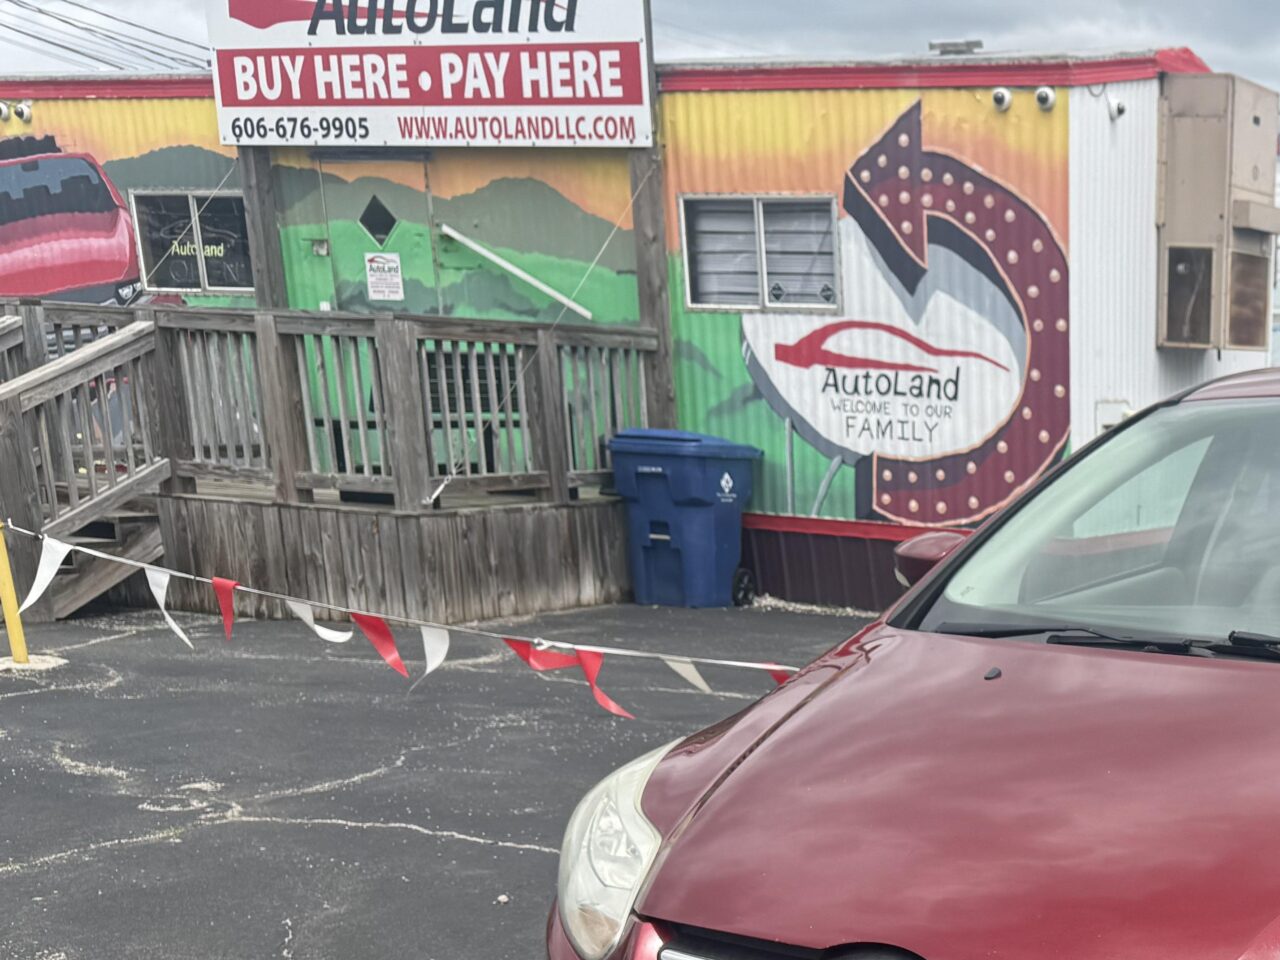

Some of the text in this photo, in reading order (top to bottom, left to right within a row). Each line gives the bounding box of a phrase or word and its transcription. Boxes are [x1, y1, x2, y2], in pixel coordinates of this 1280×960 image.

[233, 50, 623, 100] BUY HERE PAY HERE
[231, 116, 636, 140] 606-676-9905 WWW.AUTOLANDLLC.COM
[821, 366, 960, 401] AutoLand
[830, 398, 953, 419] WELCOME TO OUR
[845, 416, 939, 442] FAMILY
